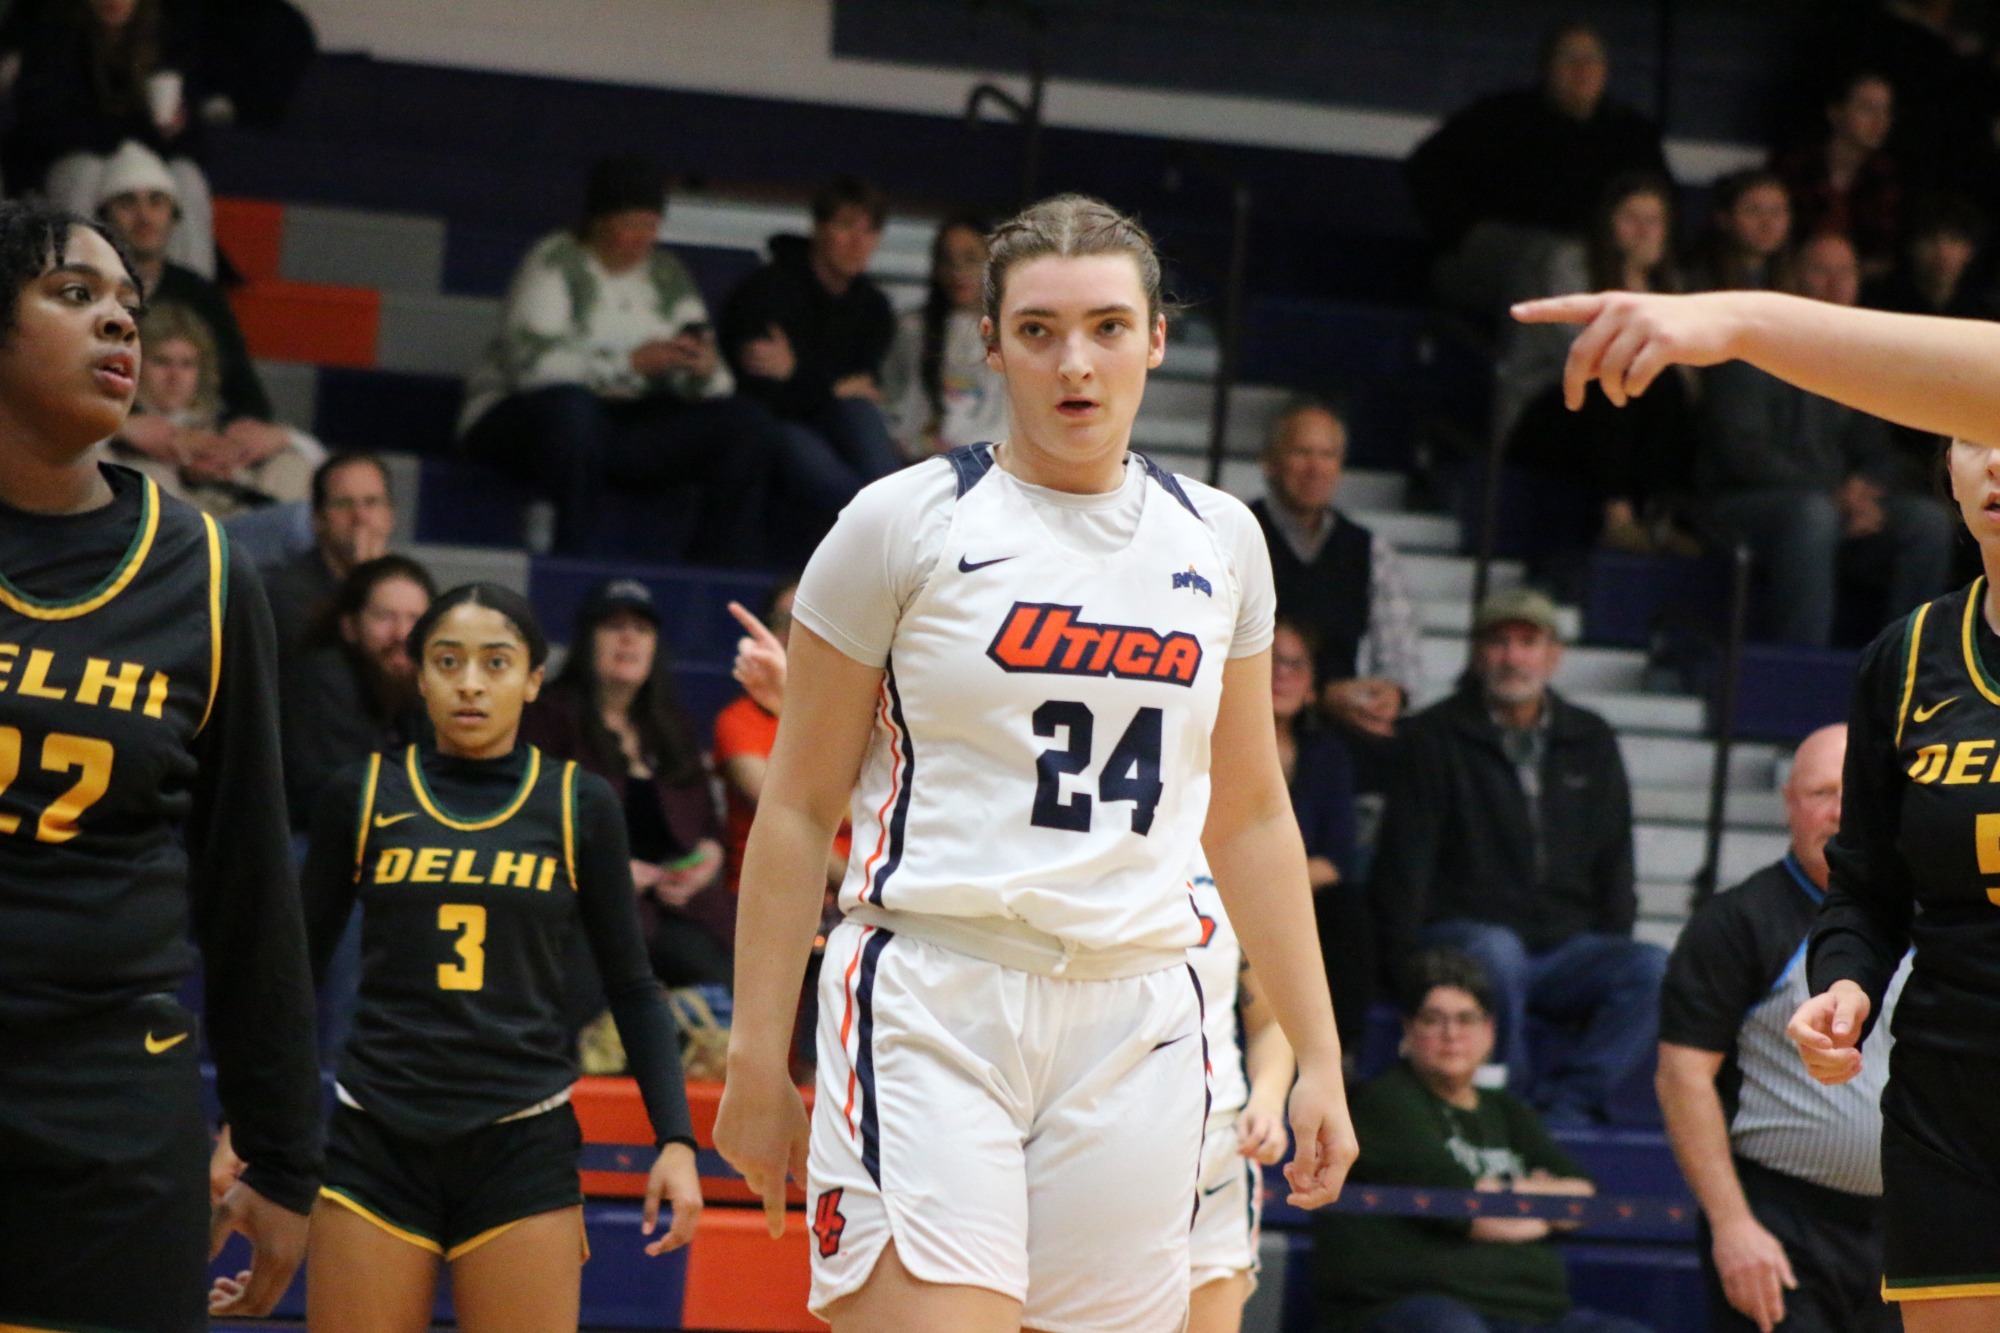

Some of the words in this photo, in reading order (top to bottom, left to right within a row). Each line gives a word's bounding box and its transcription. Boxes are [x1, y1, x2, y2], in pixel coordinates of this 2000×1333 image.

[986, 602, 1203, 687] UTICA
[0, 725, 114, 843] 2
[1030, 700, 1163, 837] 24
[1907, 739, 2000, 784] DE
[374, 847, 558, 892] DELHI
[437, 903, 487, 991] 3
